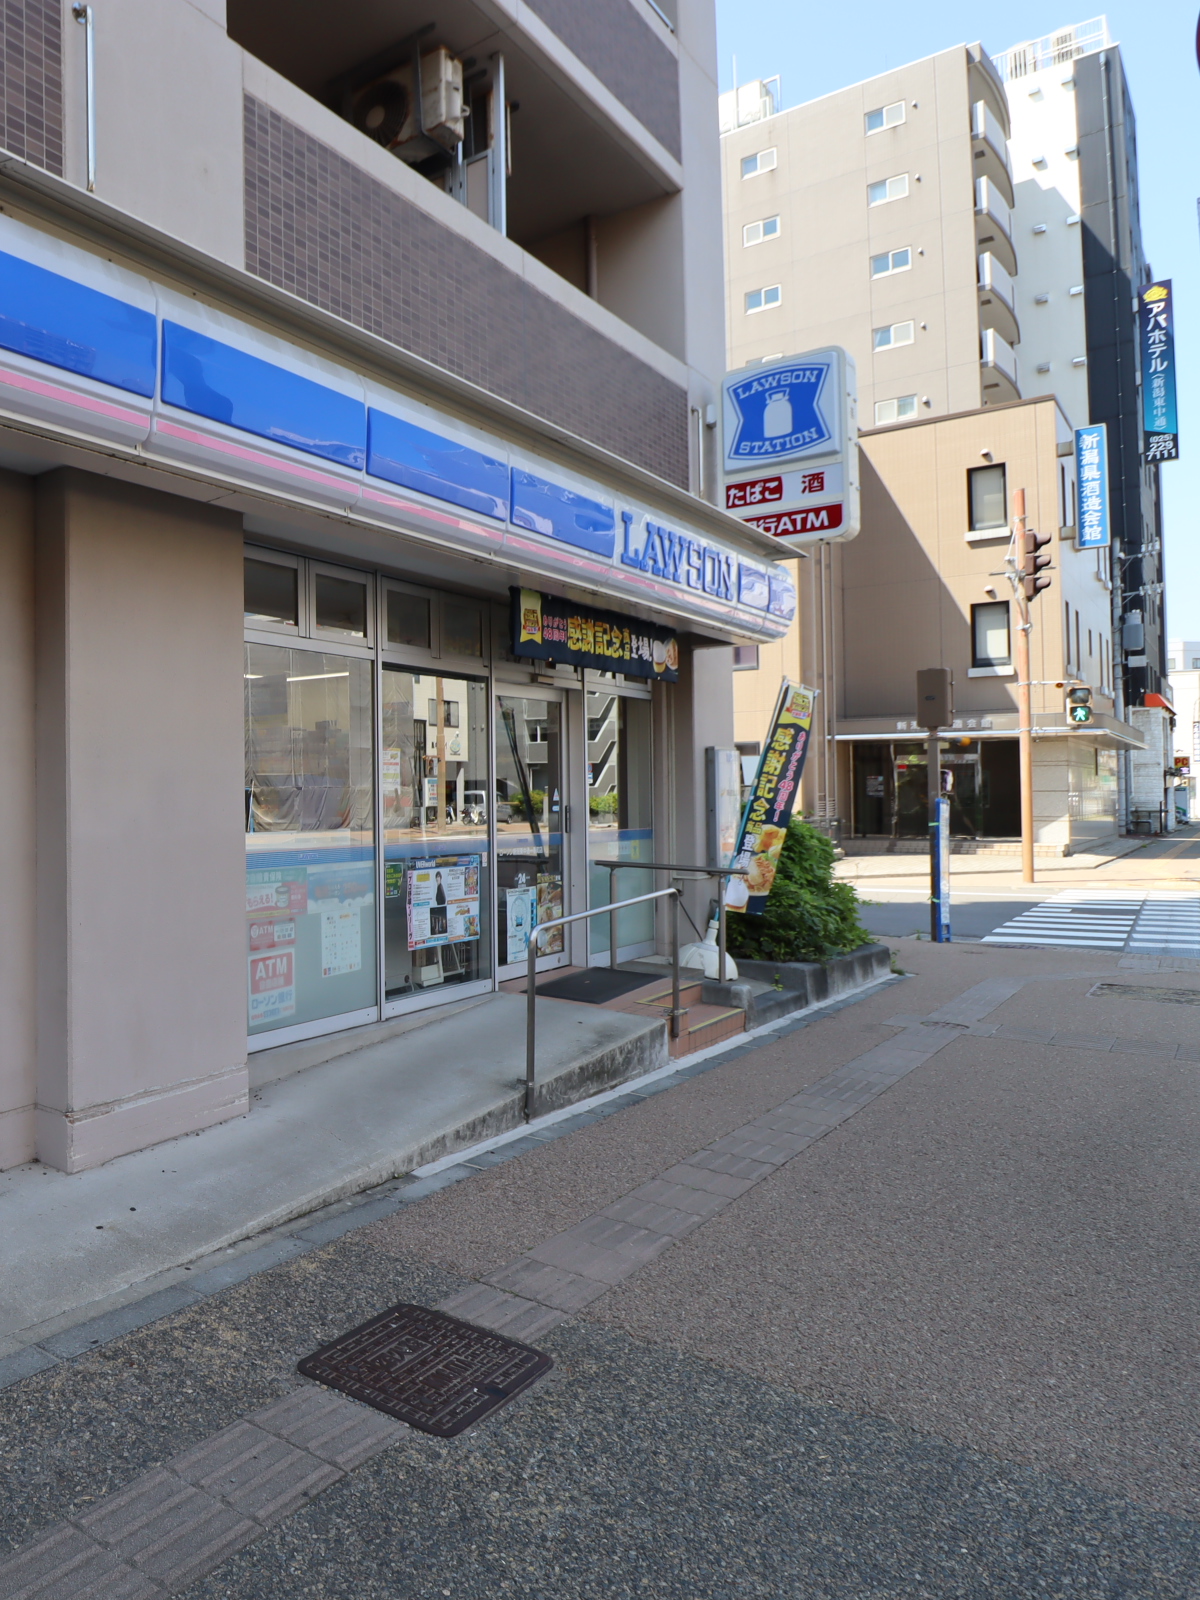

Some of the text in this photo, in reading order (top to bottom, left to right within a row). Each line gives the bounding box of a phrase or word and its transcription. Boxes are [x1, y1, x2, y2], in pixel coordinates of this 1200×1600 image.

[1146, 301, 1168, 372] アパホテル
[737, 370, 819, 399] LAWSON
[739, 427, 819, 453] STATION
[727, 481, 780, 507] たばこ
[801, 471, 825, 494] 酒
[1080, 433, 1102, 541] 新潟県酒造会館
[621, 511, 734, 600] LAWSON
[256, 957, 287, 980] ATM
